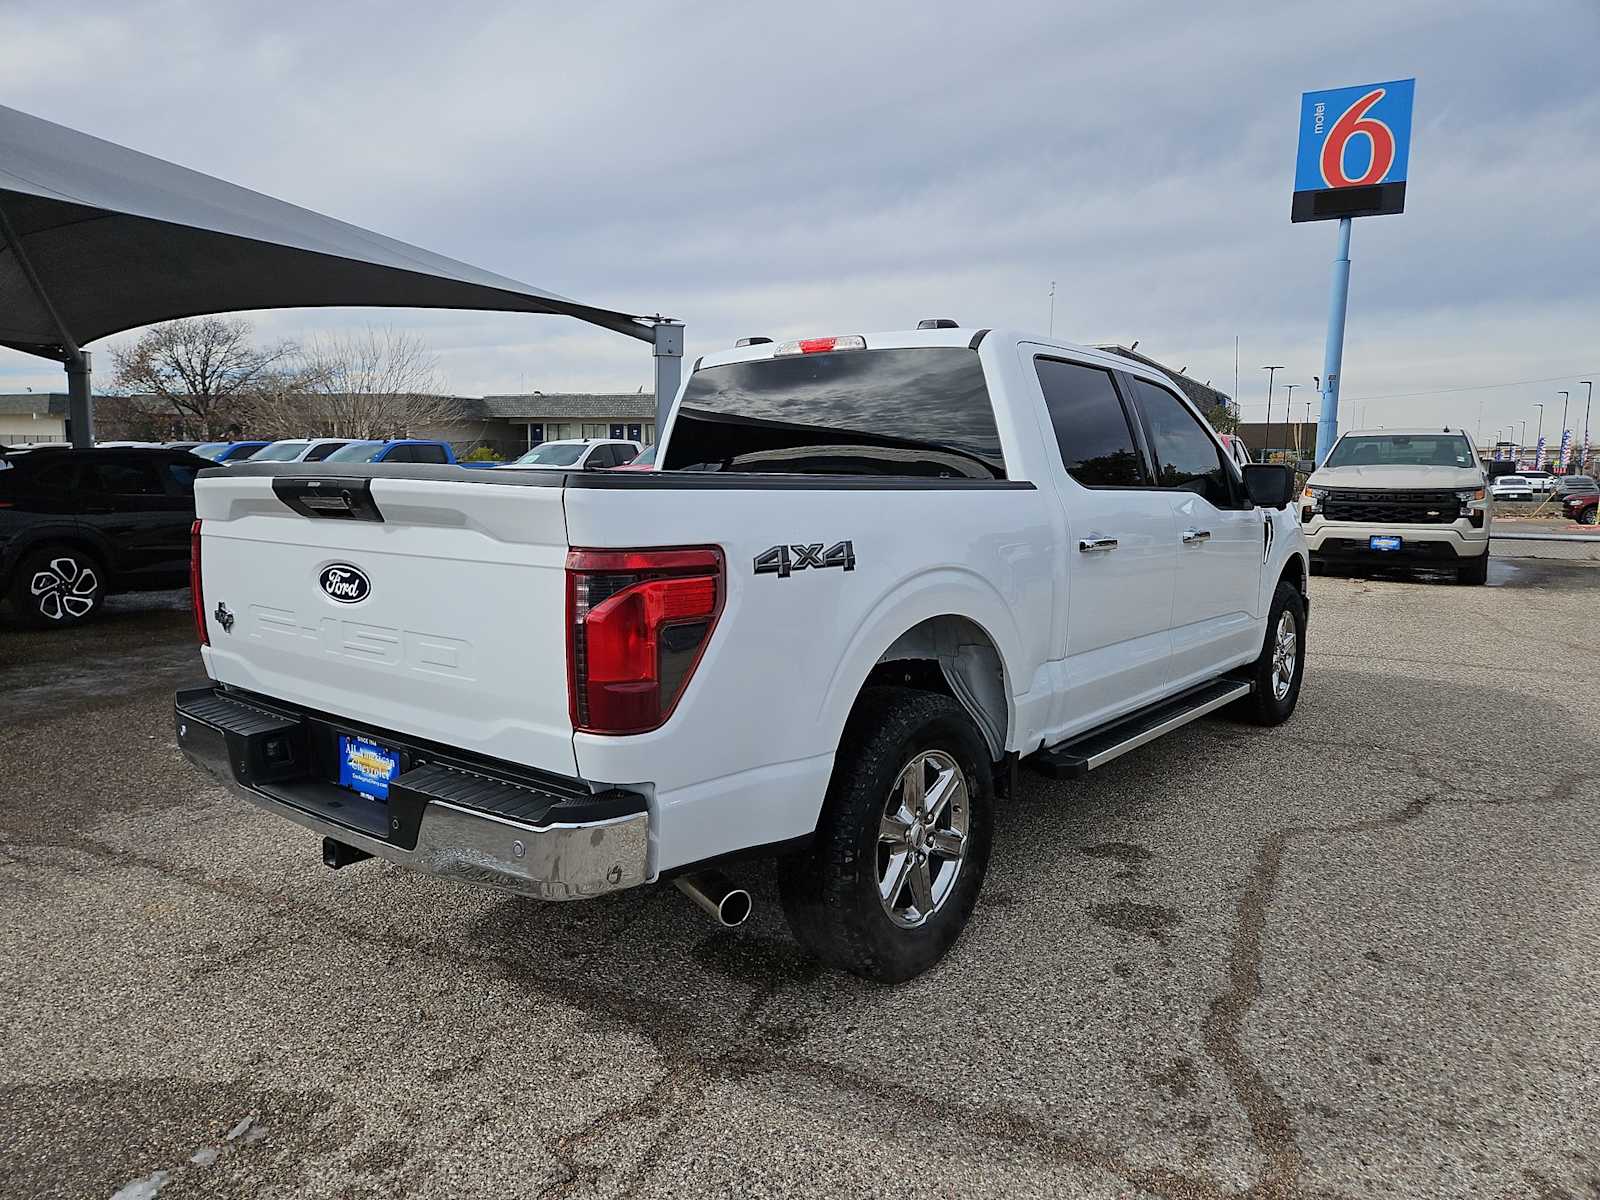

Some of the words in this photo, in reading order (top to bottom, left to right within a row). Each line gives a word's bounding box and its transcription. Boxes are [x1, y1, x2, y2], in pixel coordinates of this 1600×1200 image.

[1314, 102, 1325, 134] motel
[1320, 88, 1396, 189] 6
[325, 569, 360, 598] Ford
[248, 602, 480, 683] F-150
